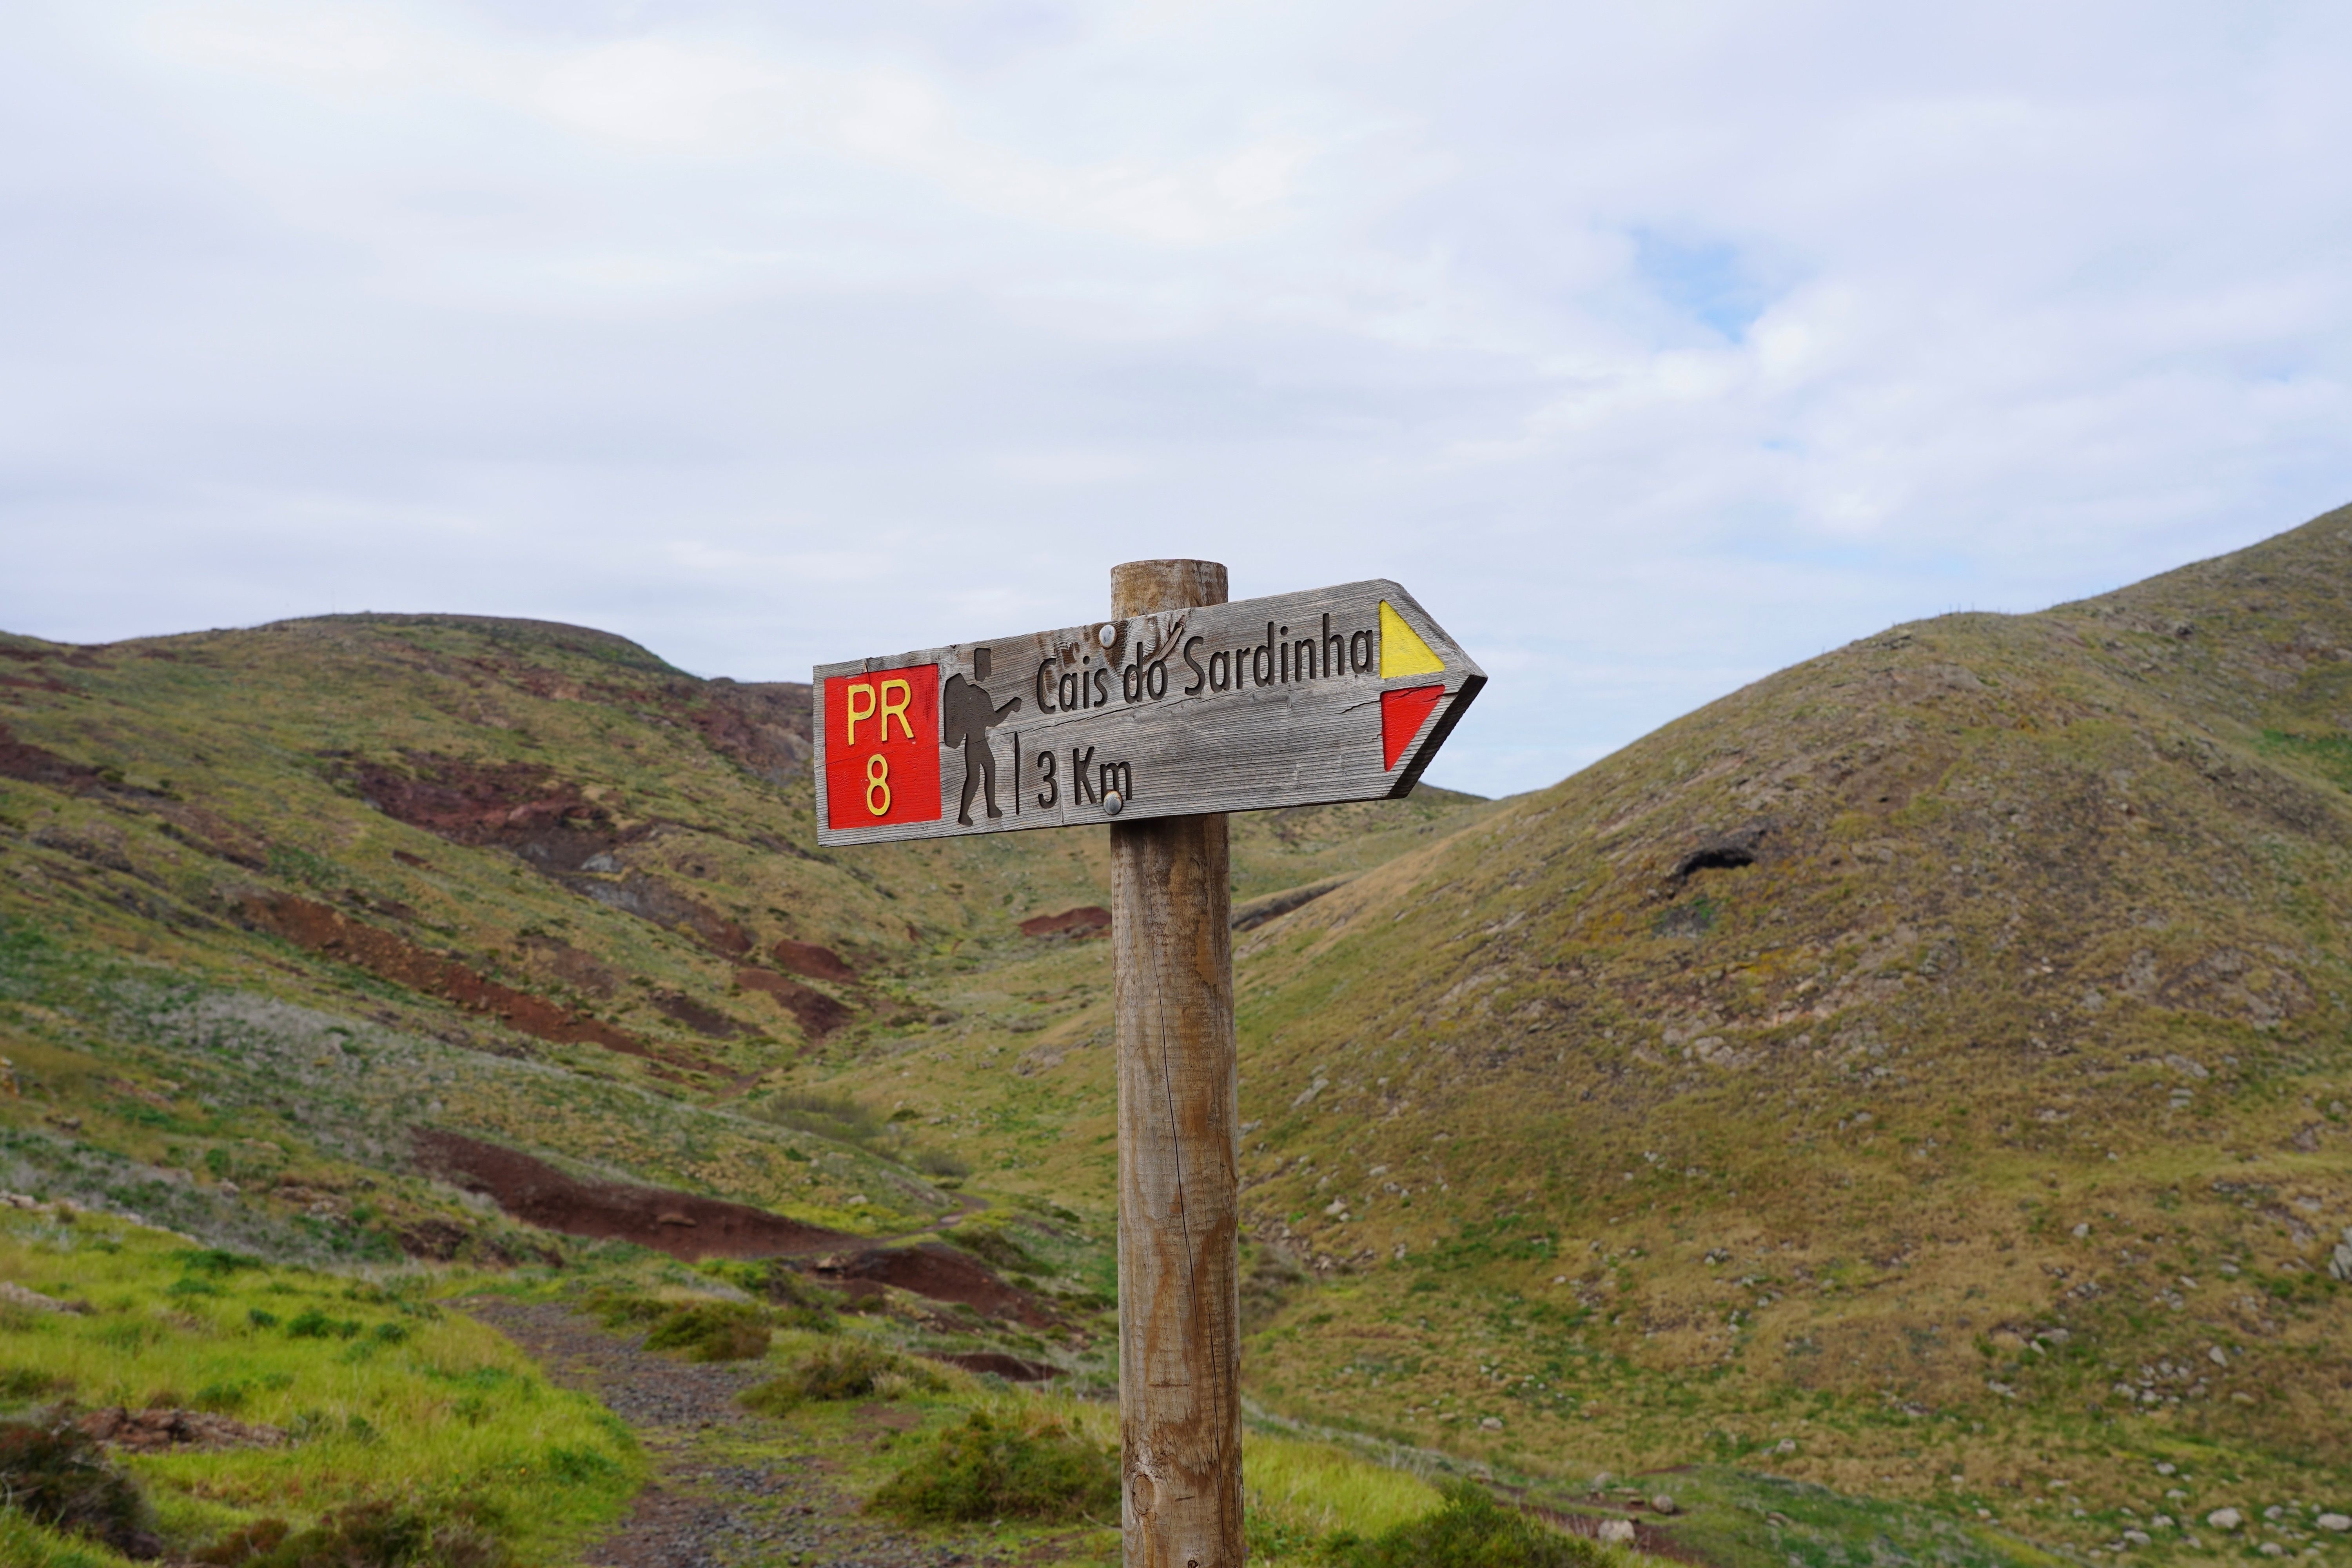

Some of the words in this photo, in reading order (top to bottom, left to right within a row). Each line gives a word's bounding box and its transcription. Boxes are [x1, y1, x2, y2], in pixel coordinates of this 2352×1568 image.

[1036, 655, 1108, 715] Cais
[1123, 641, 1168, 702] do
[1183, 612, 1373, 696] Sardinha
[848, 679, 914, 746] PR
[866, 753, 891, 817] 8
[1037, 750, 1058, 809] 3
[1073, 746, 1132, 806] Km
